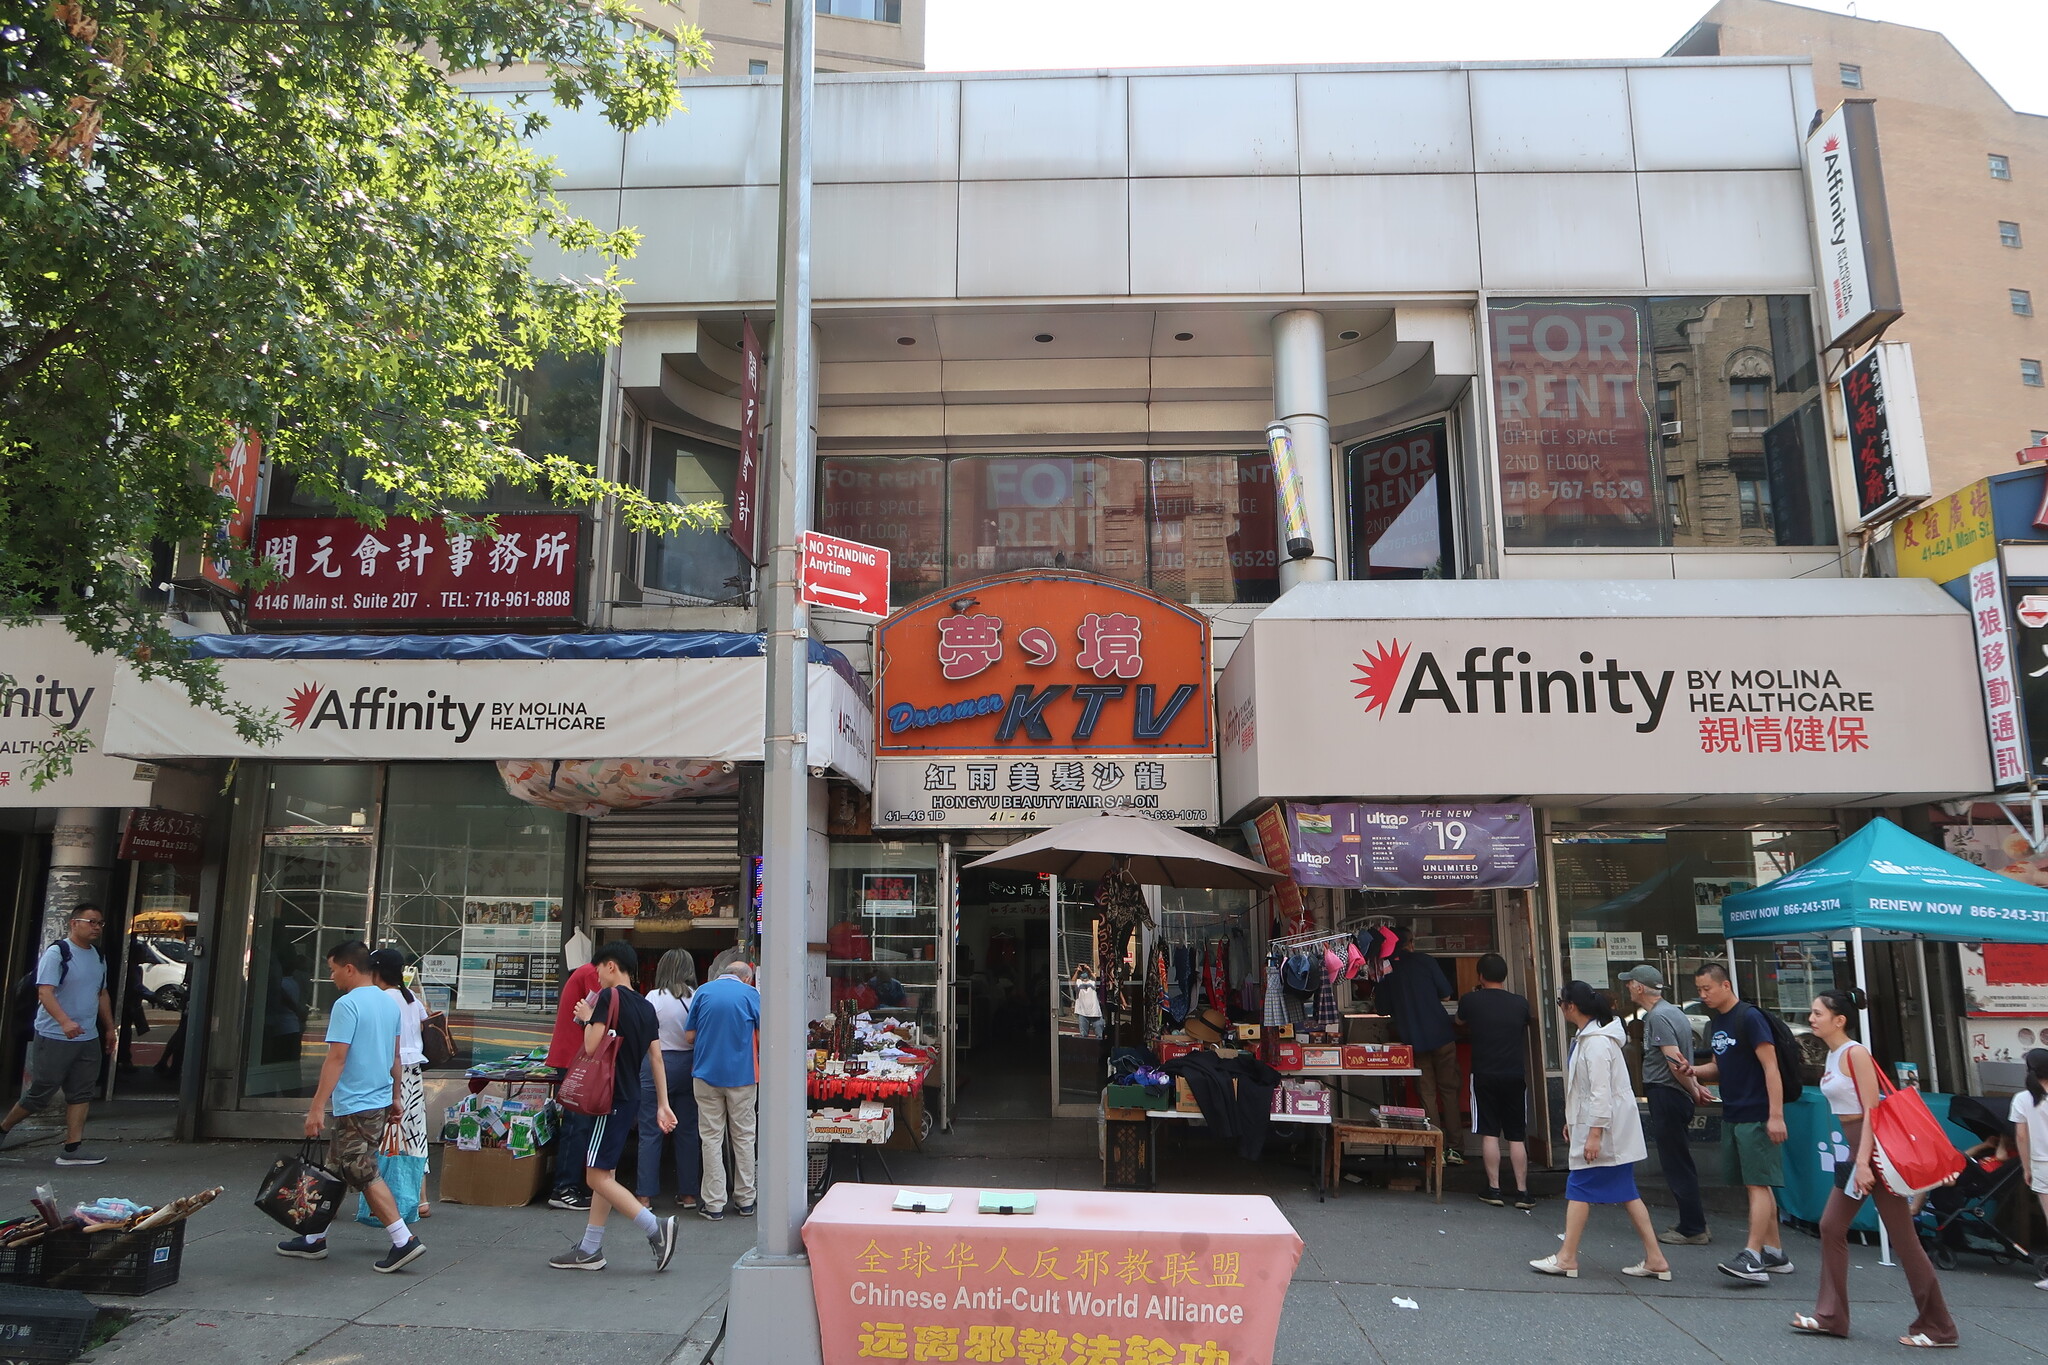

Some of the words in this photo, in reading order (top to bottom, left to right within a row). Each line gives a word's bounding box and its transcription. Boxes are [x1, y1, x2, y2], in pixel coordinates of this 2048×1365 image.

[1824, 153, 1847, 247] Affinity
[1495, 314, 1630, 363] FOR
[1500, 373, 1635, 419] RENT
[1503, 429, 1568, 446] OFFICE
[1567, 428, 1618, 446] SPACE
[1363, 438, 1433, 482] FOR
[1505, 454, 1539, 471] 2ND
[1547, 453, 1601, 471] FLOOR
[825, 469, 872, 488] FOR
[879, 466, 942, 487] RENT
[986, 462, 1108, 511] FOR
[1507, 479, 1644, 500] 718-767-6529
[1364, 469, 1434, 513] RENT
[1366, 516, 1392, 535] 2ND
[1903, 481, 1991, 550] 友誼廣場
[999, 510, 1105, 548] RENT
[1921, 537, 1953, 562] 41-42A
[1955, 527, 1978, 552] Main
[1978, 520, 1993, 541] St.
[264, 531, 571, 579] 開元會計事務所
[809, 539, 825, 555] NO
[826, 543, 876, 567] STANDING
[809, 556, 852, 577] Anytime
[255, 594, 289, 611] 4146
[293, 593, 327, 610] Main
[330, 592, 348, 610] st.
[353, 592, 388, 610] Suite
[391, 592, 418, 609] 207
[440, 592, 470, 608] TEL:
[475, 590, 571, 608] 718-961-8808
[1687, 669, 1721, 691] BY
[1731, 668, 1842, 690] MOLINA
[1973, 570, 2022, 780] 海狼移動通訊
[1398, 646, 1675, 735] Affinity
[1689, 691, 1875, 713] HEALTHCARE
[309, 686, 487, 744] Affinity
[491, 702, 515, 716] BY
[519, 702, 588, 716] MOLINA
[886, 693, 1006, 735] Dreamer
[994, 683, 1200, 741] KTV
[490, 716, 606, 731] HEALTHCARE
[1699, 716, 1870, 754] 親情健保
[923, 762, 1167, 793] 紅雨美髮沙龍
[932, 794, 1000, 810] HONGYU
[1001, 795, 1066, 810] BEAUTY
[1065, 795, 1102, 809] HAIR
[1104, 795, 1159, 809] SALON
[1420, 809, 1442, 818] THE
[1447, 809, 1473, 818] NEW
[927, 810, 946, 822] 1D
[1137, 809, 1208, 822] 6-633-1078
[132, 836, 160, 848] Income
[162, 839, 174, 849] Tax
[175, 841, 188, 850] $25
[1427, 820, 1468, 850] $19
[1422, 864, 1479, 872] UNLIMITED
[875, 877, 905, 889] FOR
[1730, 909, 1758, 922] RENEW
[1759, 906, 1779, 919] NOW
[1783, 898, 1841, 916] 866-243-3174
[1869, 898, 1923, 914] RENEW
[1926, 902, 1963, 916] NOW
[1970, 905, 2048, 923] 866-243-31
[854, 1237, 1245, 1289] 全球华人反邪教联盟
[849, 1280, 947, 1311] Chinese
[952, 1284, 1061, 1315] Anti-Cult
[1068, 1290, 1140, 1319] World
[1145, 1293, 1244, 1325] Alliance
